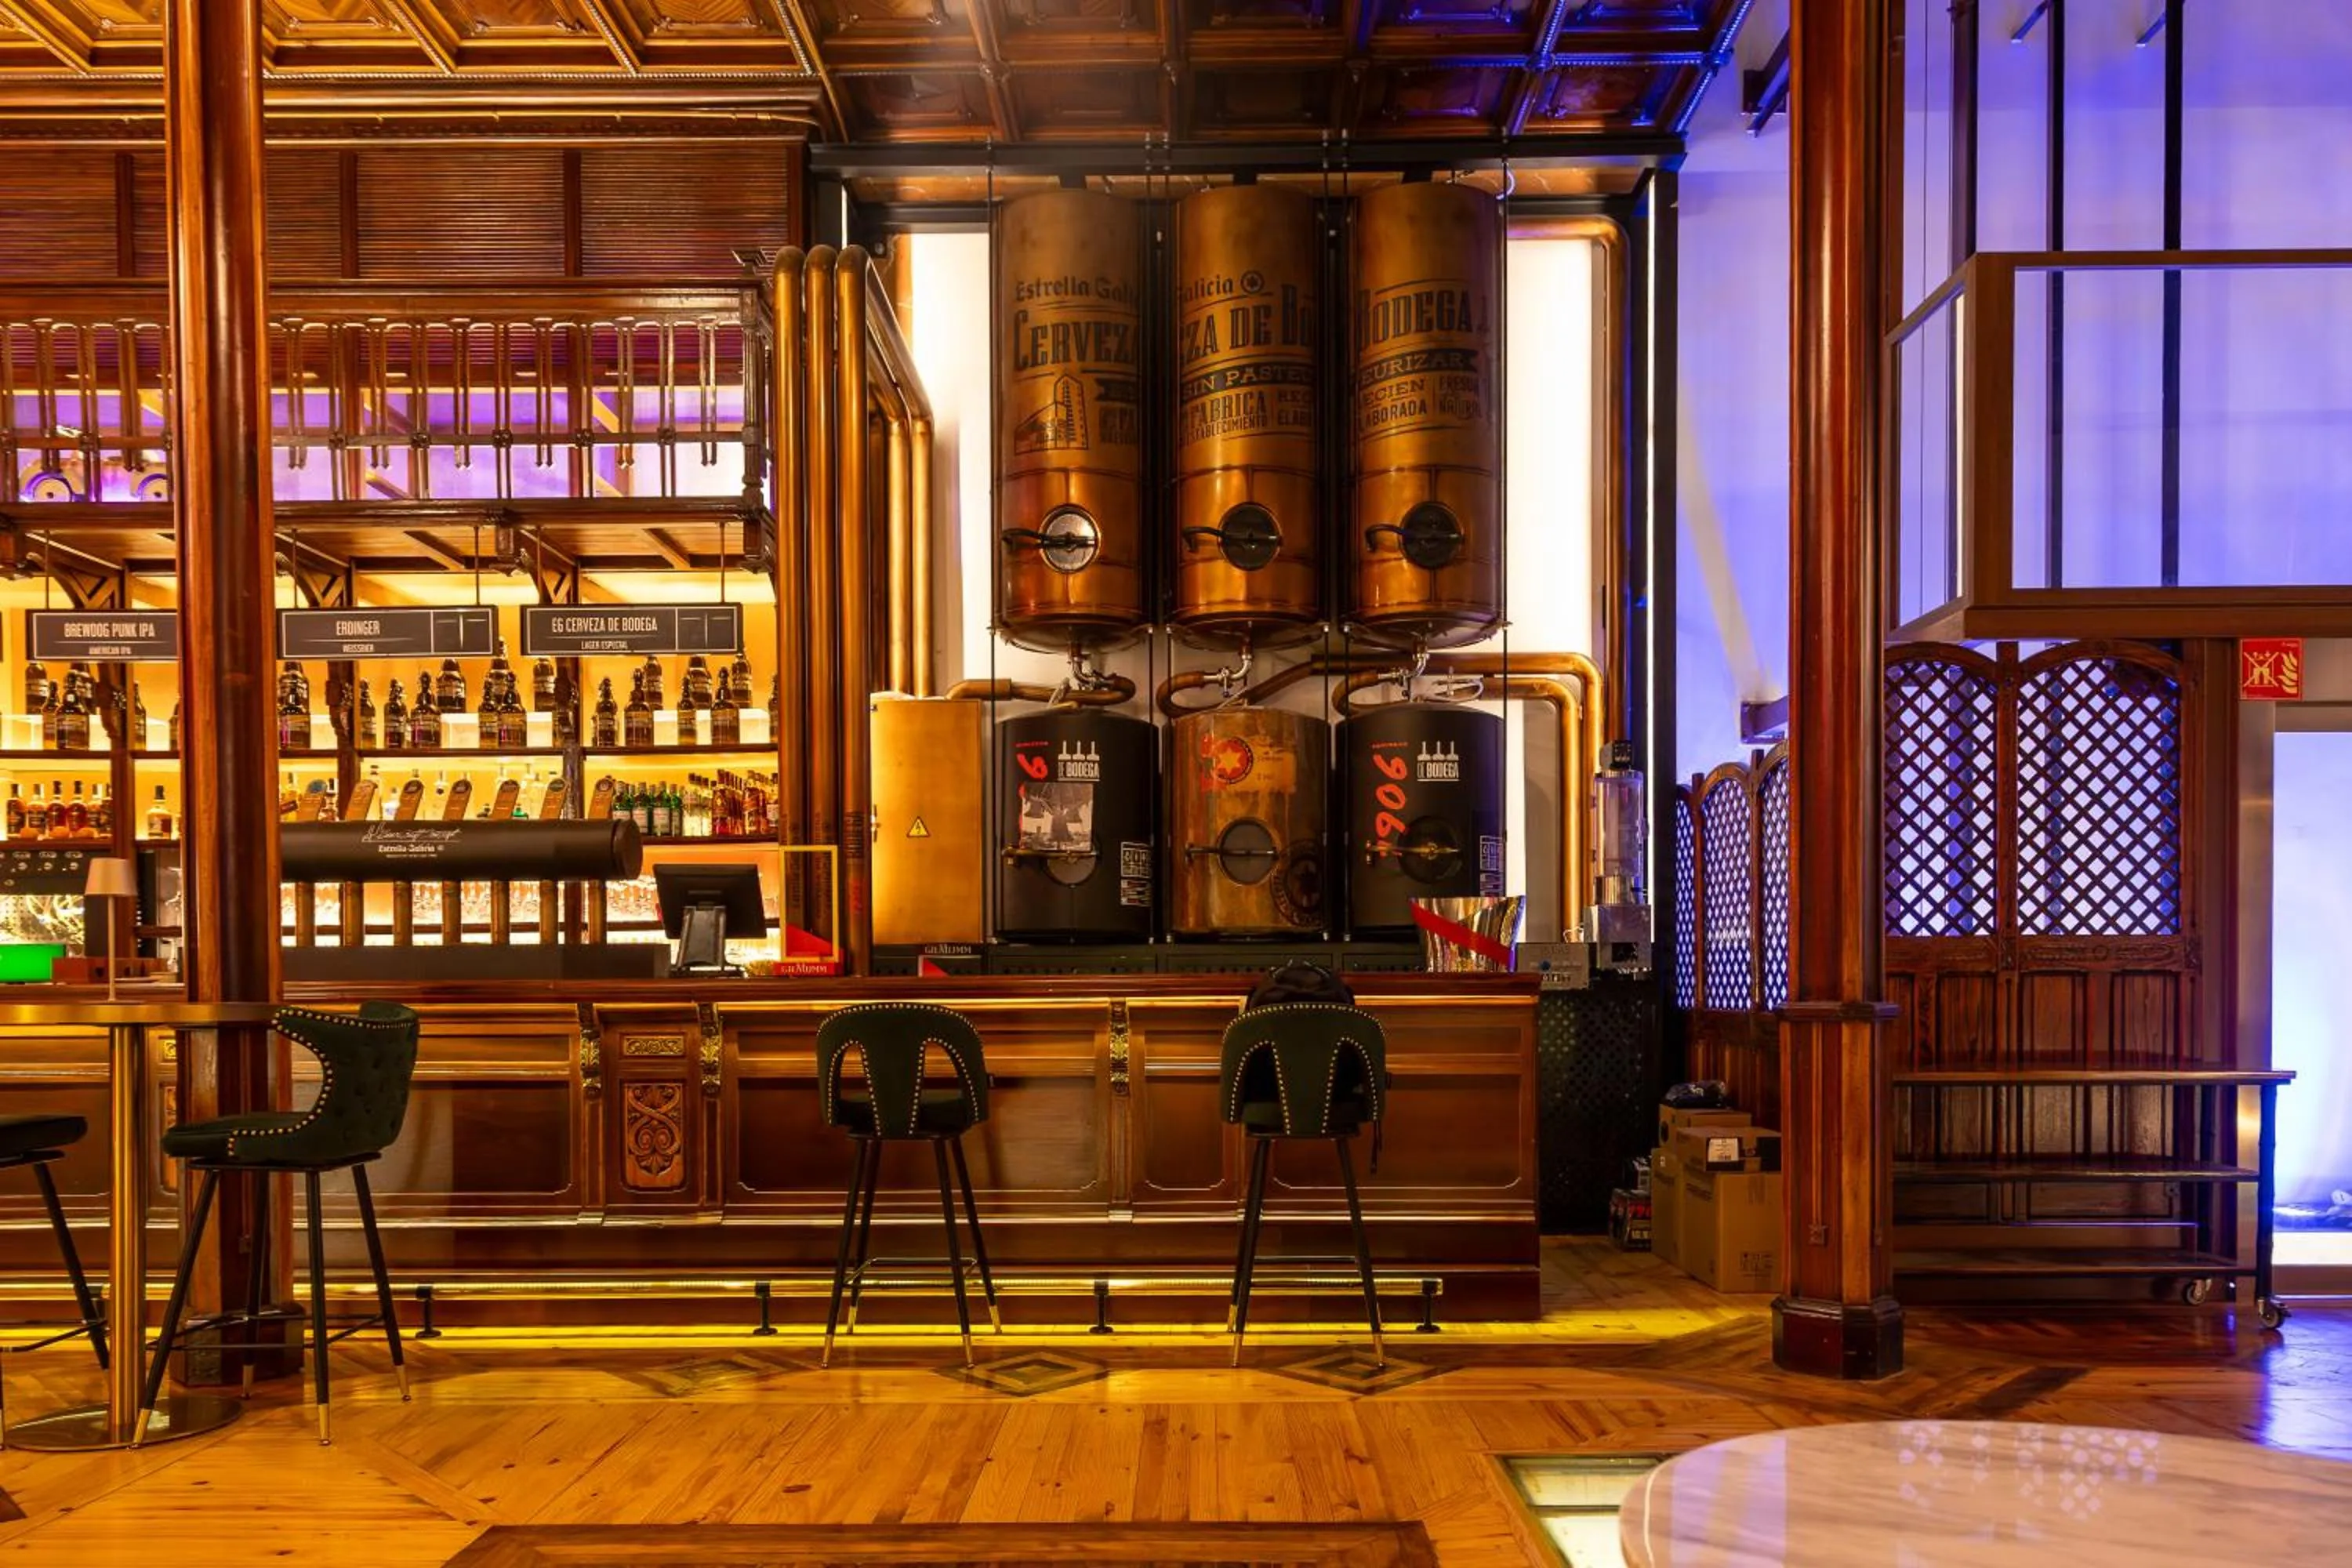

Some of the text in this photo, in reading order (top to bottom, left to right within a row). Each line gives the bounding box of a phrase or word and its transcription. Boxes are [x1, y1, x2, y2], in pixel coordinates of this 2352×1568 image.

[1015, 275, 1090, 302] Estrella
[1178, 274, 1234, 303] alicia
[1229, 304, 1272, 350] DE
[1360, 352, 1465, 384] EURIZAR
[1363, 379, 1425, 406] ECIEN
[112, 622, 137, 637] PUNK
[139, 622, 155, 637] IPA
[336, 620, 380, 636] ERDINGER
[565, 617, 605, 633] CERVEZA
[608, 617, 620, 632] DE
[622, 616, 658, 632] BODEGA
[1065, 761, 1100, 778] BODEGA
[1426, 761, 1459, 779] BODEGA
